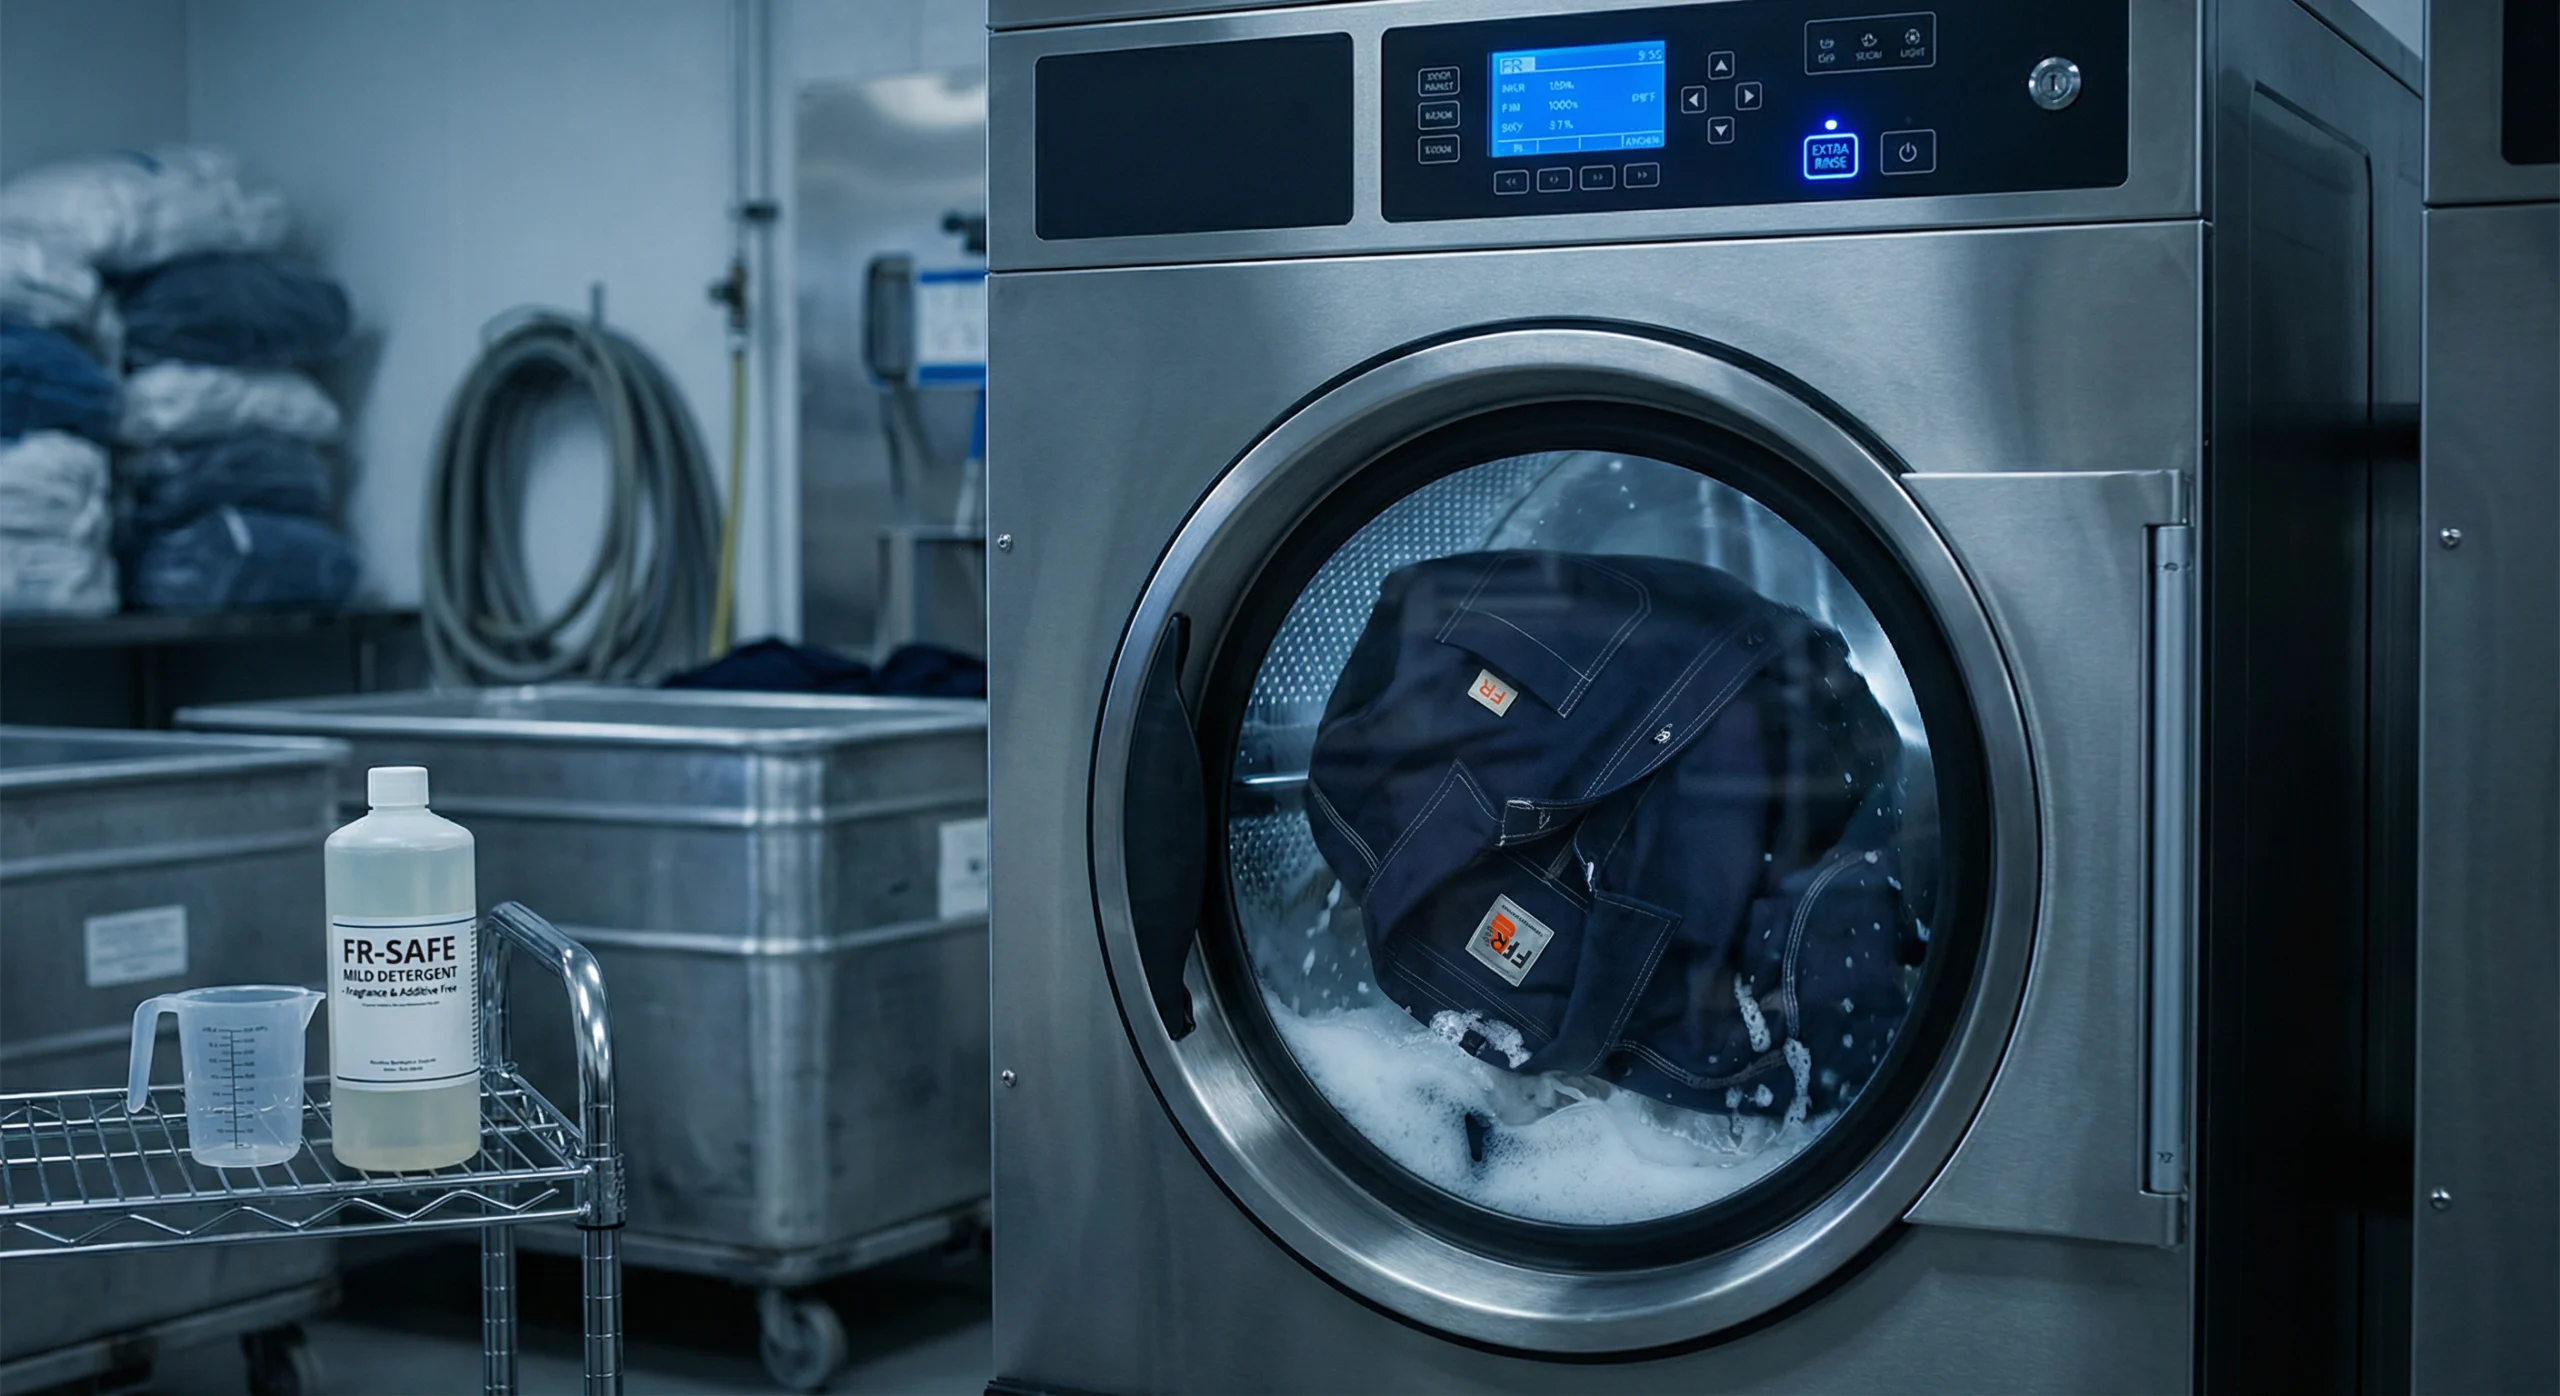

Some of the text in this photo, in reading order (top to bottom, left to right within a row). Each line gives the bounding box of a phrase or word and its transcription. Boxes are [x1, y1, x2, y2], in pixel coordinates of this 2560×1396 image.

[1502, 59, 1522, 72] FR
[1812, 143, 1850, 156] EXTRA
[1479, 678, 1507, 705] FR
[343, 935, 456, 965] FR-SAFE
[343, 965, 458, 983] MILD DETERGENT
